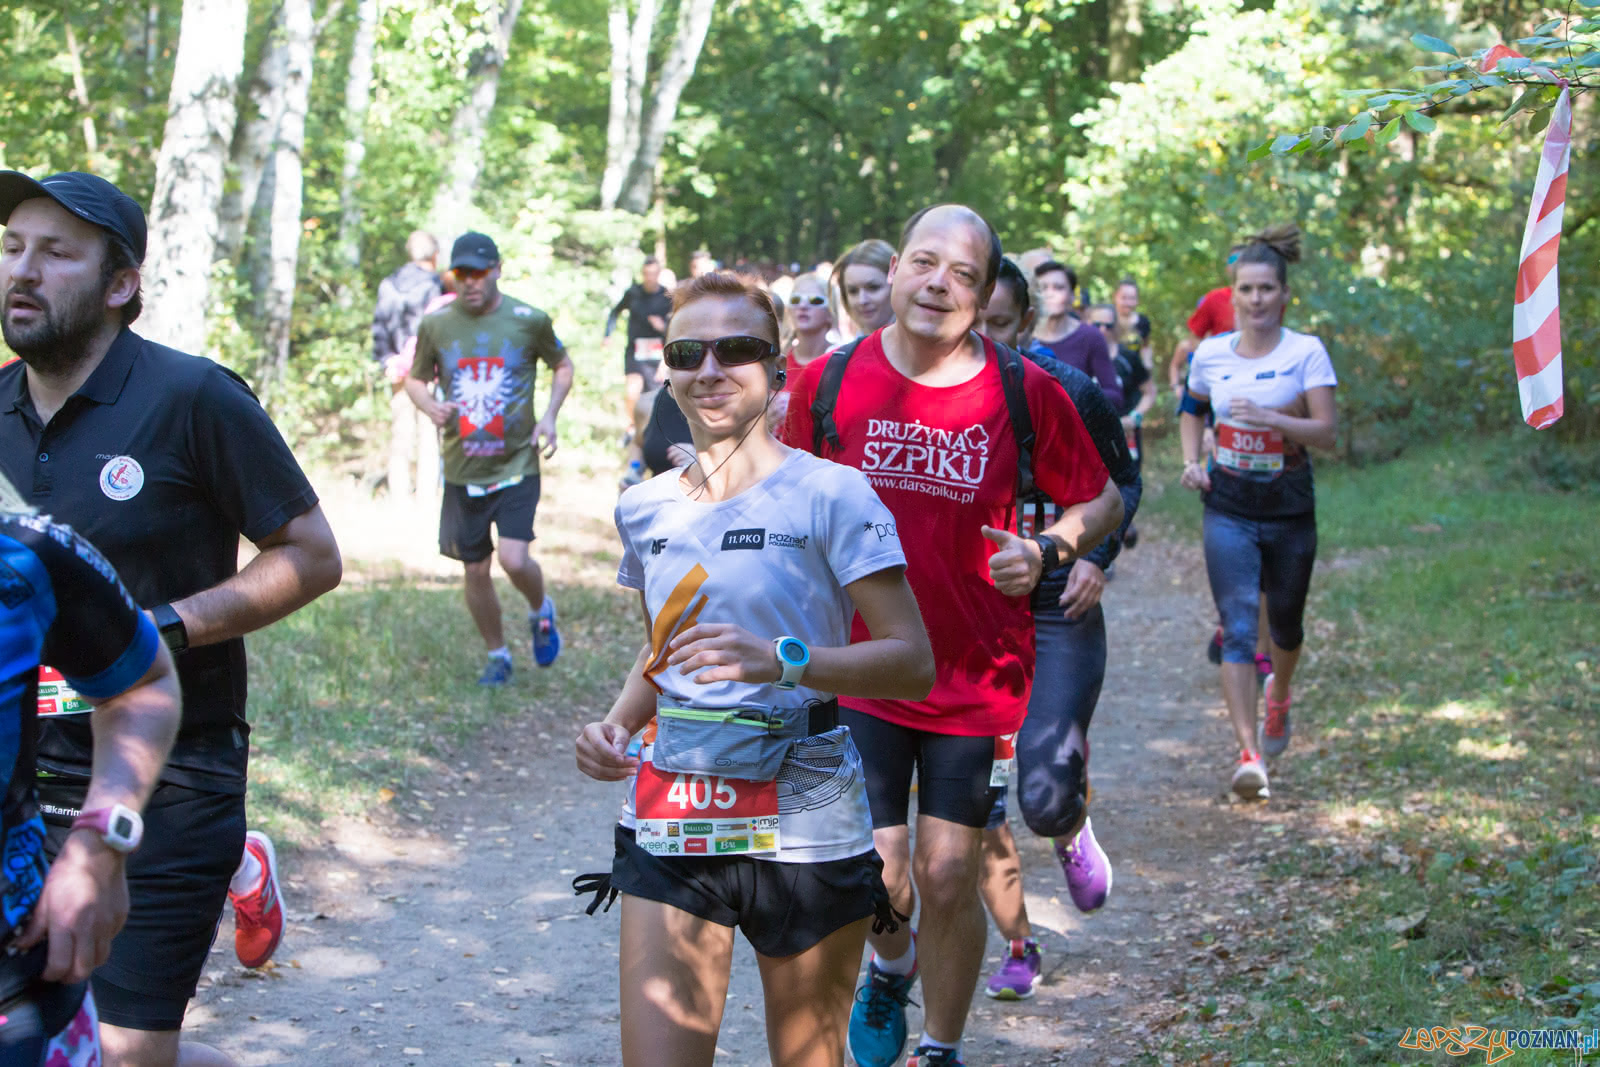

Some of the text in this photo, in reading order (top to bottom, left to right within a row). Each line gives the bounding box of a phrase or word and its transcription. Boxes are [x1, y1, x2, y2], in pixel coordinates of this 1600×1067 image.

[866, 419, 967, 452] DRUŻYNA
[1231, 431, 1265, 452] 306
[861, 441, 988, 484] SZPIKU
[667, 773, 737, 810] 405
